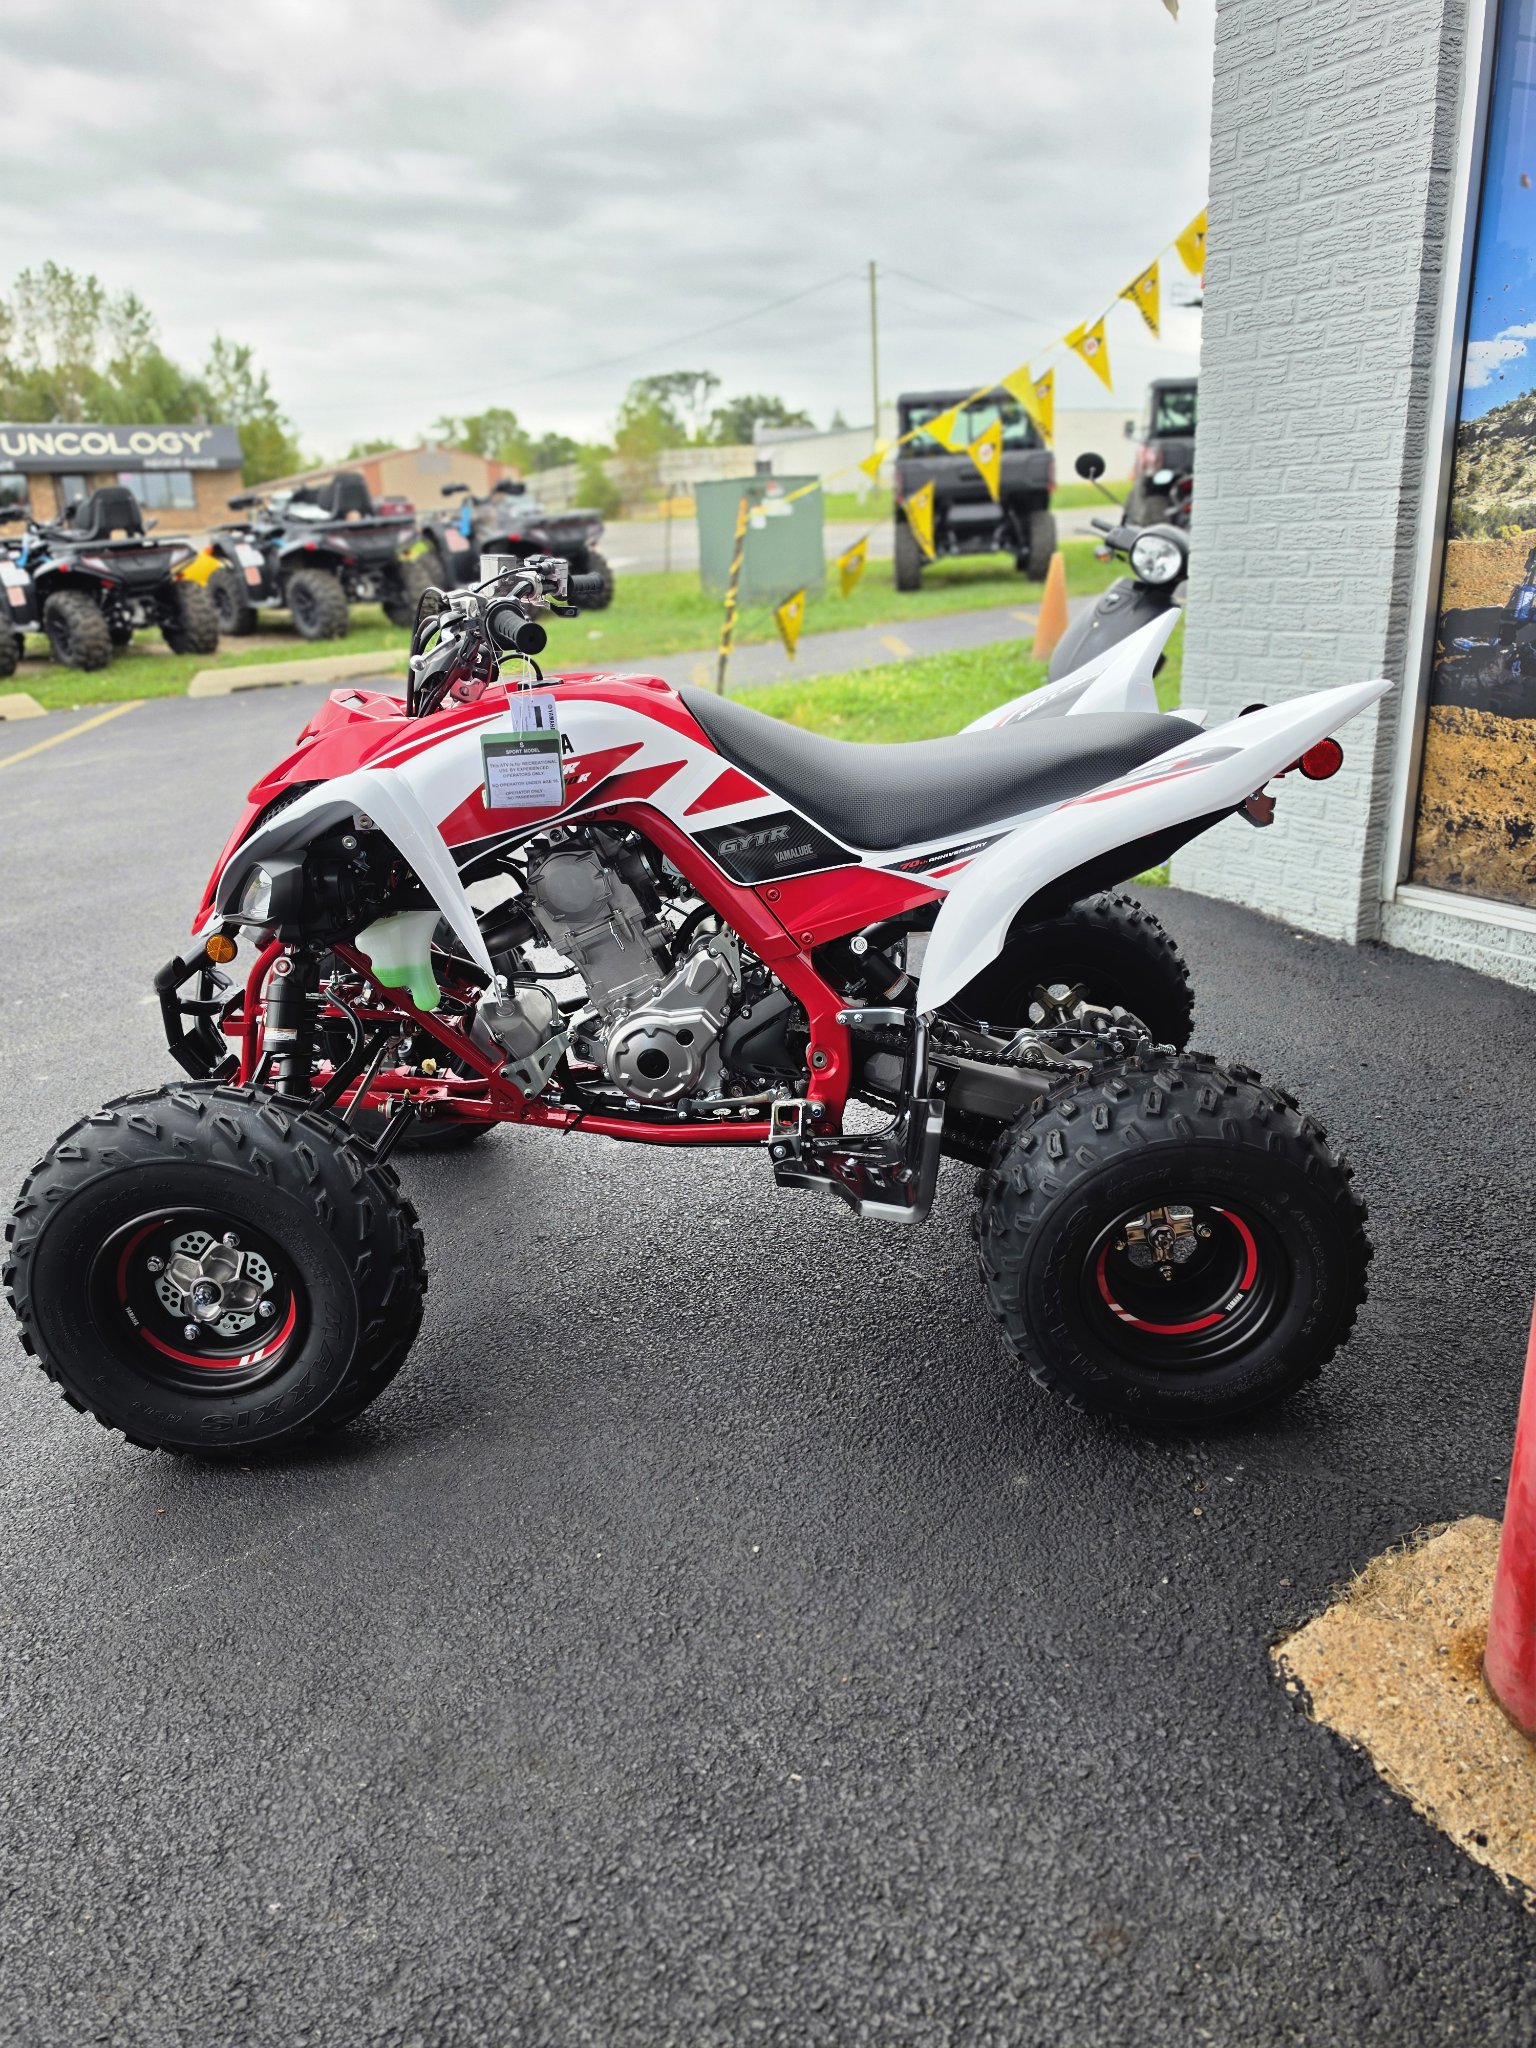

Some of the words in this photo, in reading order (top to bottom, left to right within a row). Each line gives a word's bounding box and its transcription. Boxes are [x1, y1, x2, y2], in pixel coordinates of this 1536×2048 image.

[718, 824, 791, 856] GYTR
[774, 843, 814, 863] YAMALUBE
[928, 841, 988, 863] ANNIVERSARY
[1225, 1292, 1244, 1311] YAMAHA
